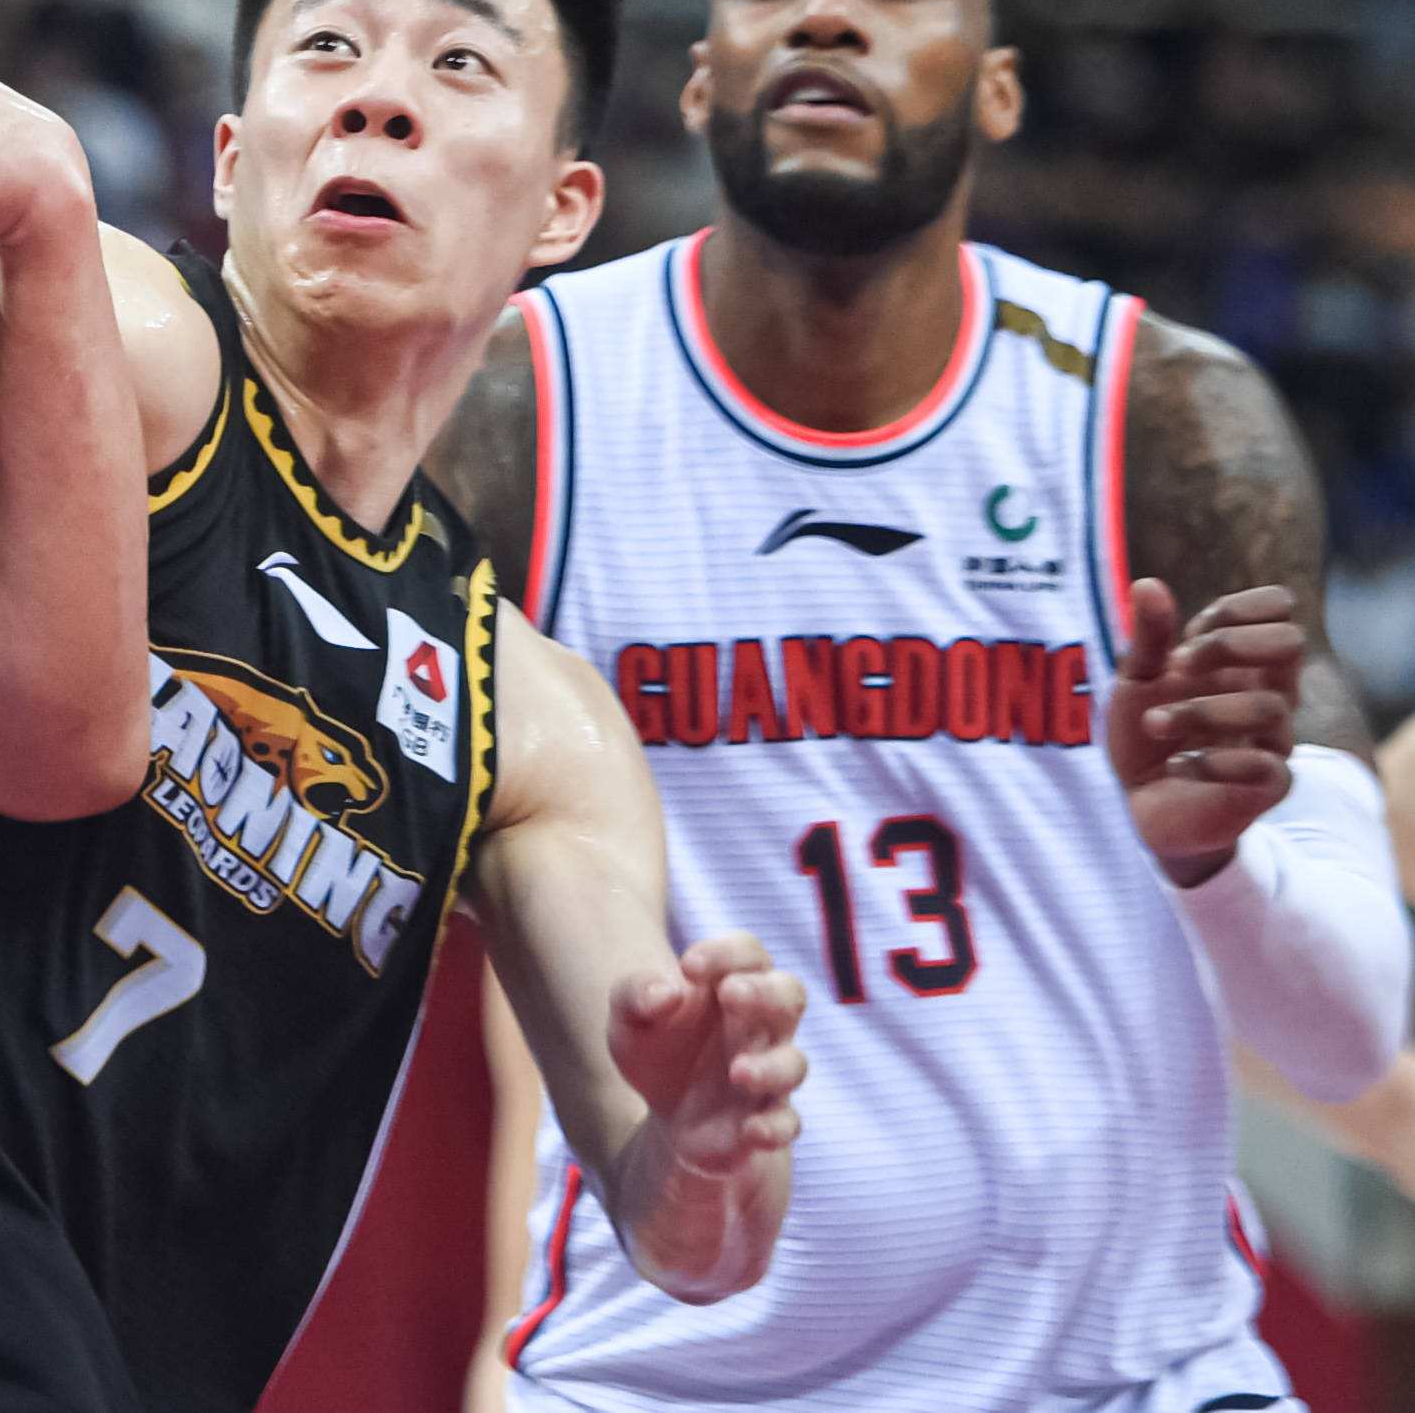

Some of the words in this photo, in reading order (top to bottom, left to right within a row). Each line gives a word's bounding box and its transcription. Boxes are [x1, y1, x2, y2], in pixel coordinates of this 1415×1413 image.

[615, 635, 1092, 748] GUANGDONG
[148, 655, 423, 974] AONING
[795, 814, 981, 1005] 13
[49, 885, 207, 1086] 7
